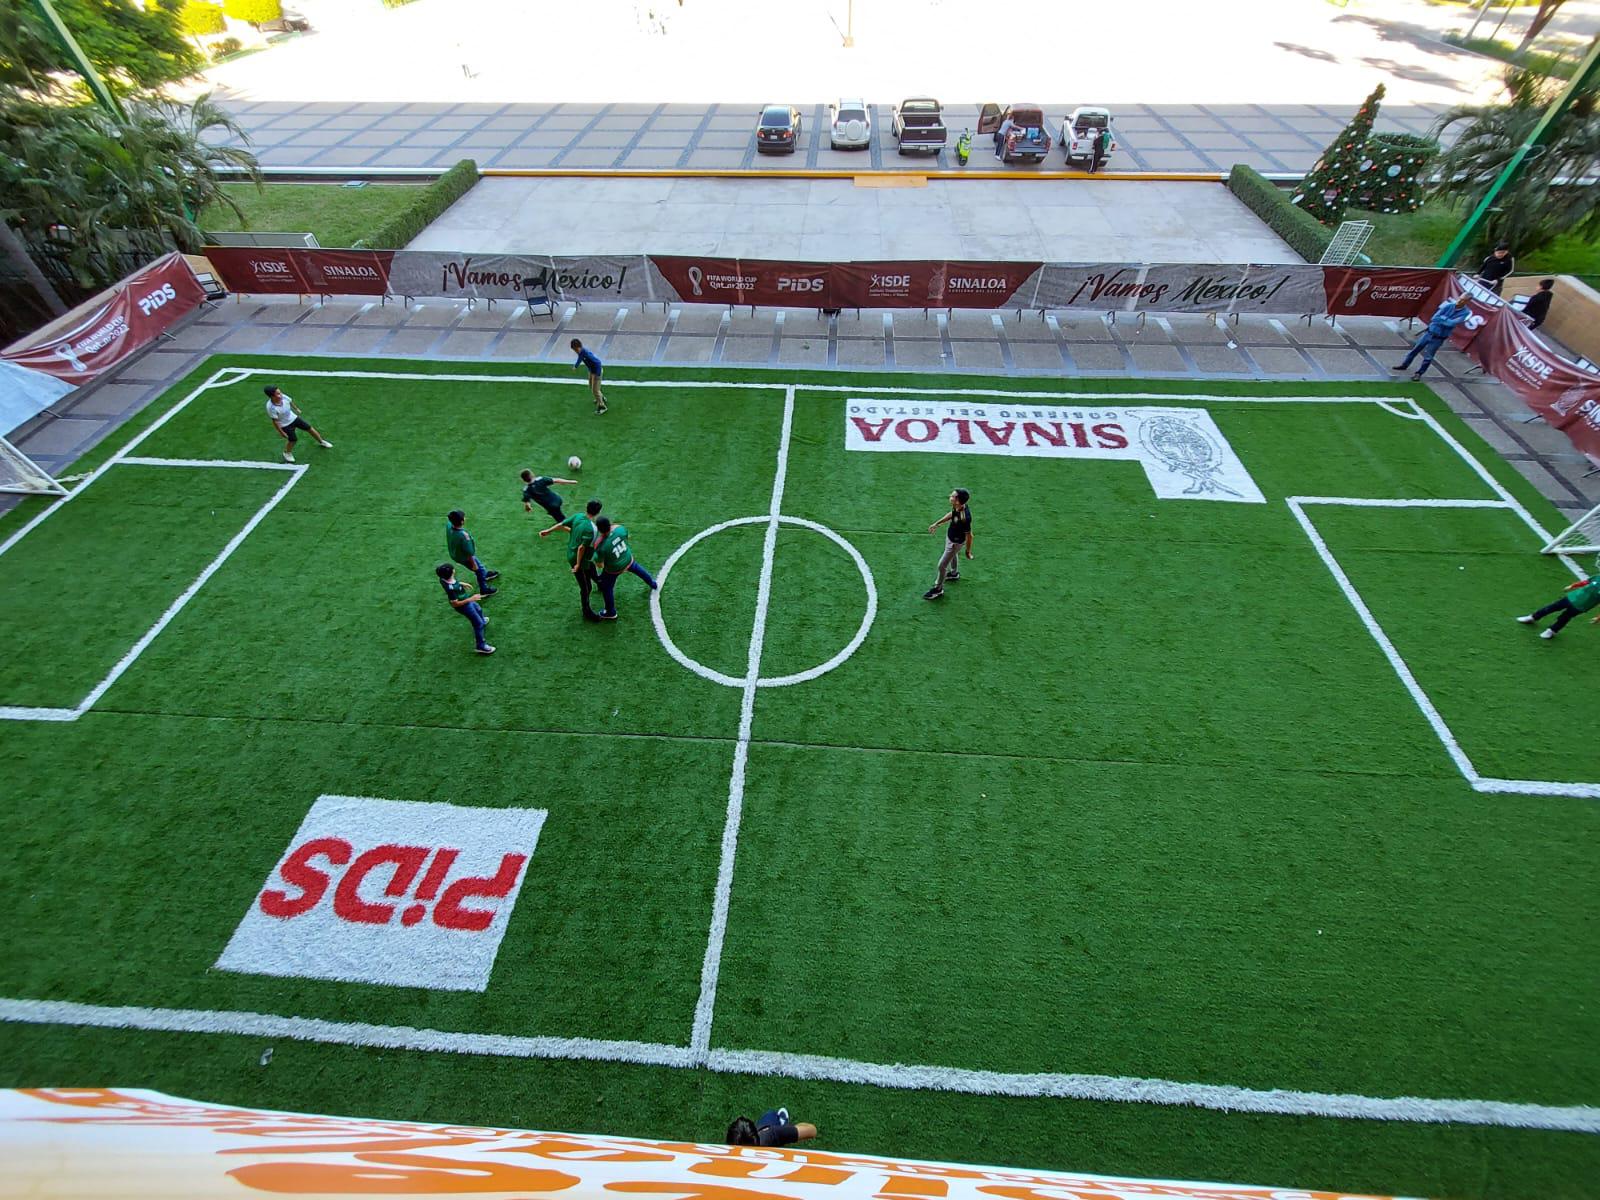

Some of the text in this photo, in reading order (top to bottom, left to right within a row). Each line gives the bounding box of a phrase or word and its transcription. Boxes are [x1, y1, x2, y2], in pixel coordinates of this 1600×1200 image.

[262, 261, 289, 273] ISDE
[323, 265, 378, 277] SINALOA
[442, 258, 627, 294] ¡Vamos México!
[777, 277, 825, 292] PiDS
[881, 275, 911, 287] ISDE
[948, 277, 1006, 289] SINALOA
[1068, 268, 1291, 305] ¡Vamos México!
[138, 283, 176, 316] PiDS
[1522, 350, 1554, 380] ISDE
[850, 406, 1118, 420] GOBIERNO DEL ESTADO
[850, 417, 1128, 449] SINALOA
[259, 835, 527, 932] PiDS
